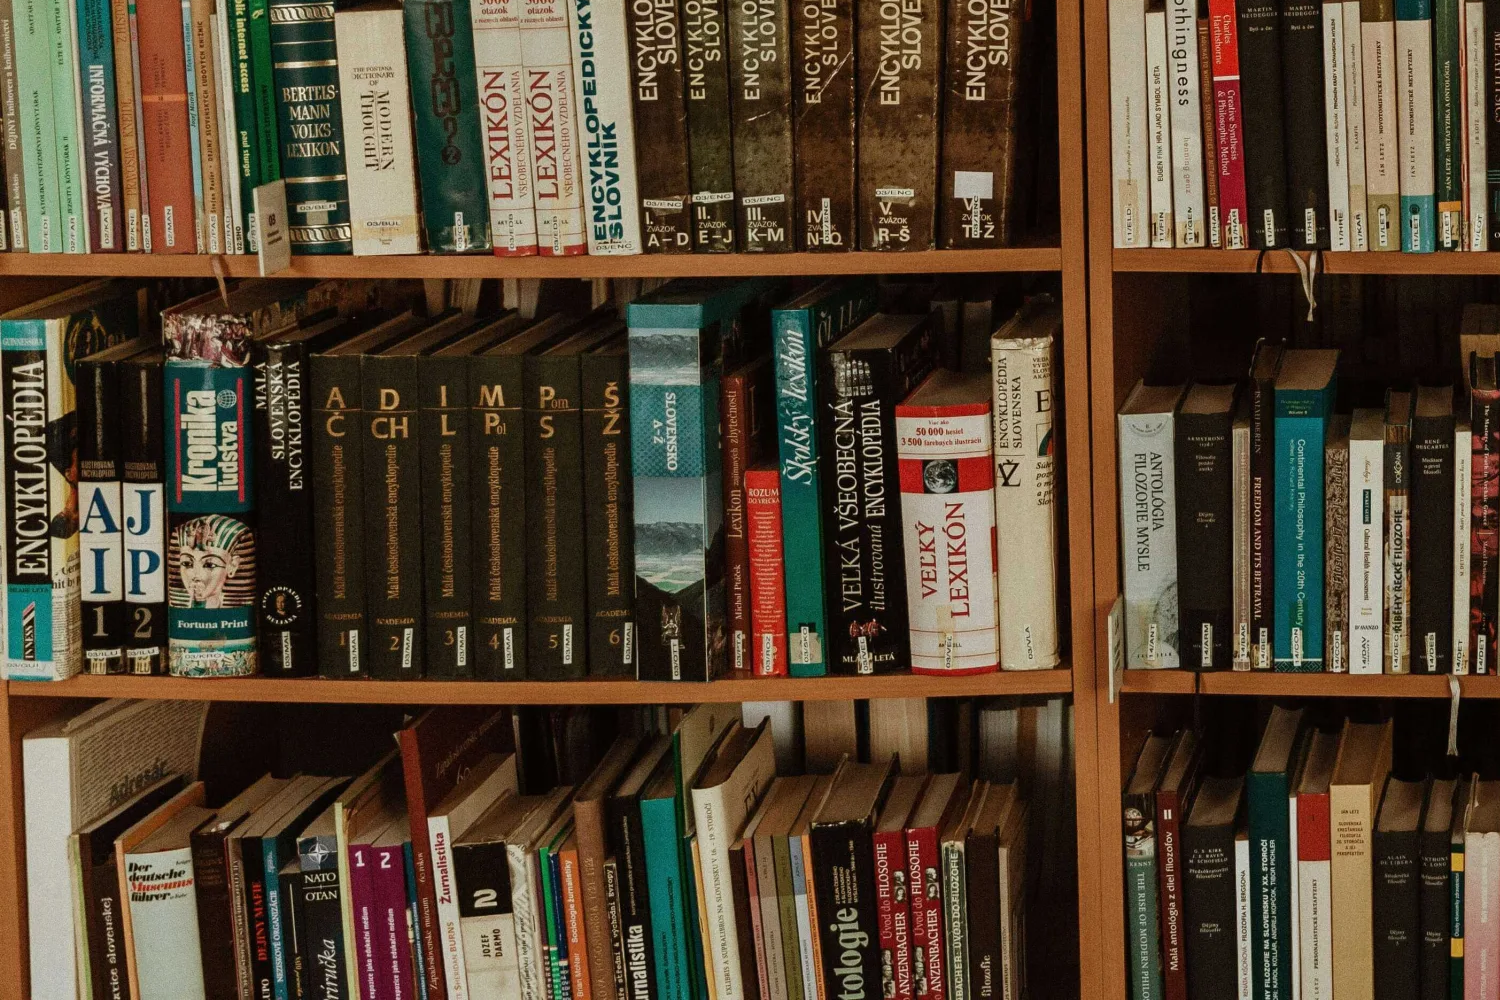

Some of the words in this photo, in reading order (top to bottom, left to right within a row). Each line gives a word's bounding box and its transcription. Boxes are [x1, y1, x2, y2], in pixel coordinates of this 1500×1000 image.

[290, 105, 329, 118] MANN
[287, 142, 340, 157] LEXIKON
[481, 70, 513, 201] LEXIKÓN
[599, 121, 623, 240] SLOVNÍK
[781, 329, 807, 403] lexikón
[180, 390, 217, 492] Kronika
[666, 392, 676, 471] SLOVENSKO
[6, 360, 50, 576] ENCYKLOPÉDIA
[829, 399, 859, 531] VŠEOBECNÁ
[859, 400, 885, 517] ENCYKLOPÉDIA
[79, 487, 121, 533] A
[127, 489, 156, 536] J
[1150, 452, 1166, 532] ANTOLÓGIA
[127, 549, 160, 595] P
[943, 502, 969, 618] LEXIKÓN
[93, 606, 108, 637] 1
[135, 607, 152, 638] 2
[177, 619, 217, 629] Fortuna
[221, 619, 248, 629] Print
[128, 863, 152, 872] Der
[355, 851, 365, 868] 1
[380, 852, 391, 868] 2
[437, 832, 451, 905] Žurnalistika
[877, 843, 889, 898] FILOSOFIE
[1165, 831, 1175, 872] filozofov
[129, 869, 186, 881] deutsche
[304, 871, 336, 884] NATO
[305, 890, 338, 902] OTAN
[1167, 875, 1176, 891] diel
[882, 916, 892, 940] Úvod
[1168, 902, 1178, 946] antológia
[894, 911, 909, 995] ANZENBACHER
[1169, 948, 1179, 971] Malá
